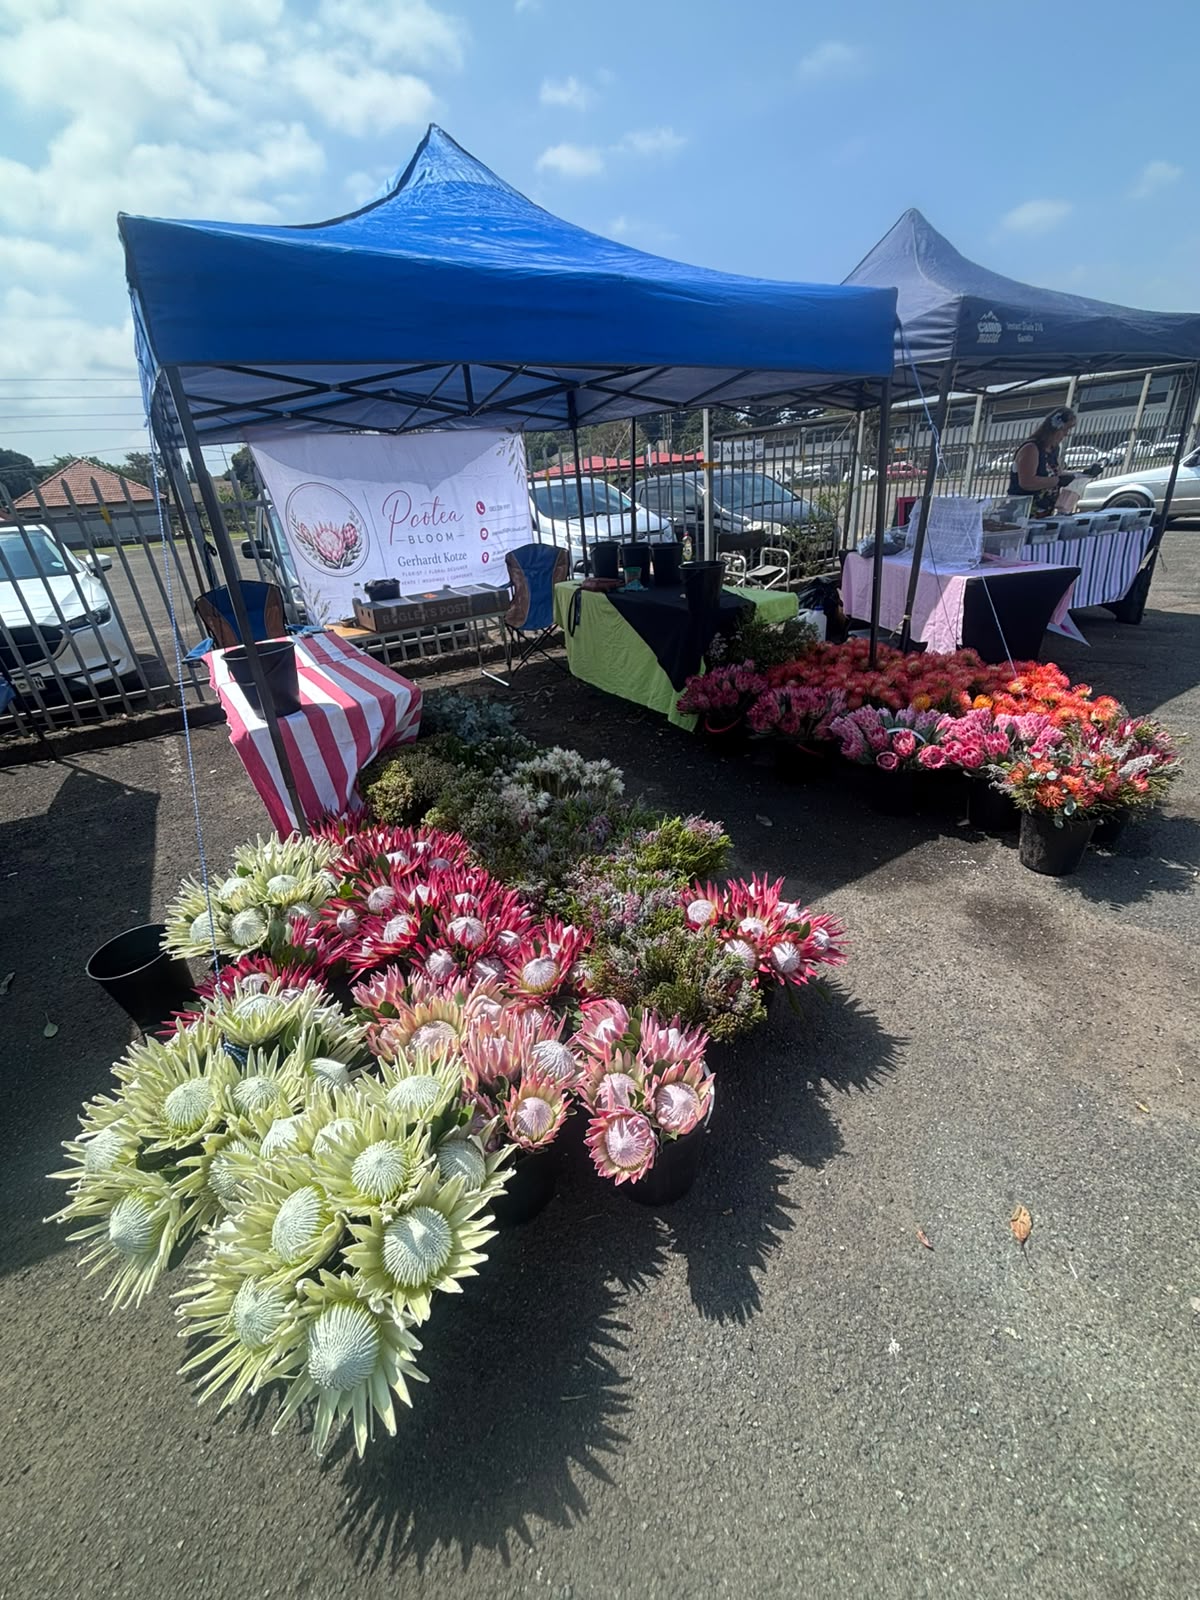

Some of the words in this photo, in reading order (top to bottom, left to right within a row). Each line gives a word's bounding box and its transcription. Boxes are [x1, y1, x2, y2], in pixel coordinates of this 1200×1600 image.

[408, 532, 454, 545] BLOOM
[397, 552, 442, 567] Gerhardt
[443, 551, 468, 564] Kotze
[440, 603, 467, 617] POST
